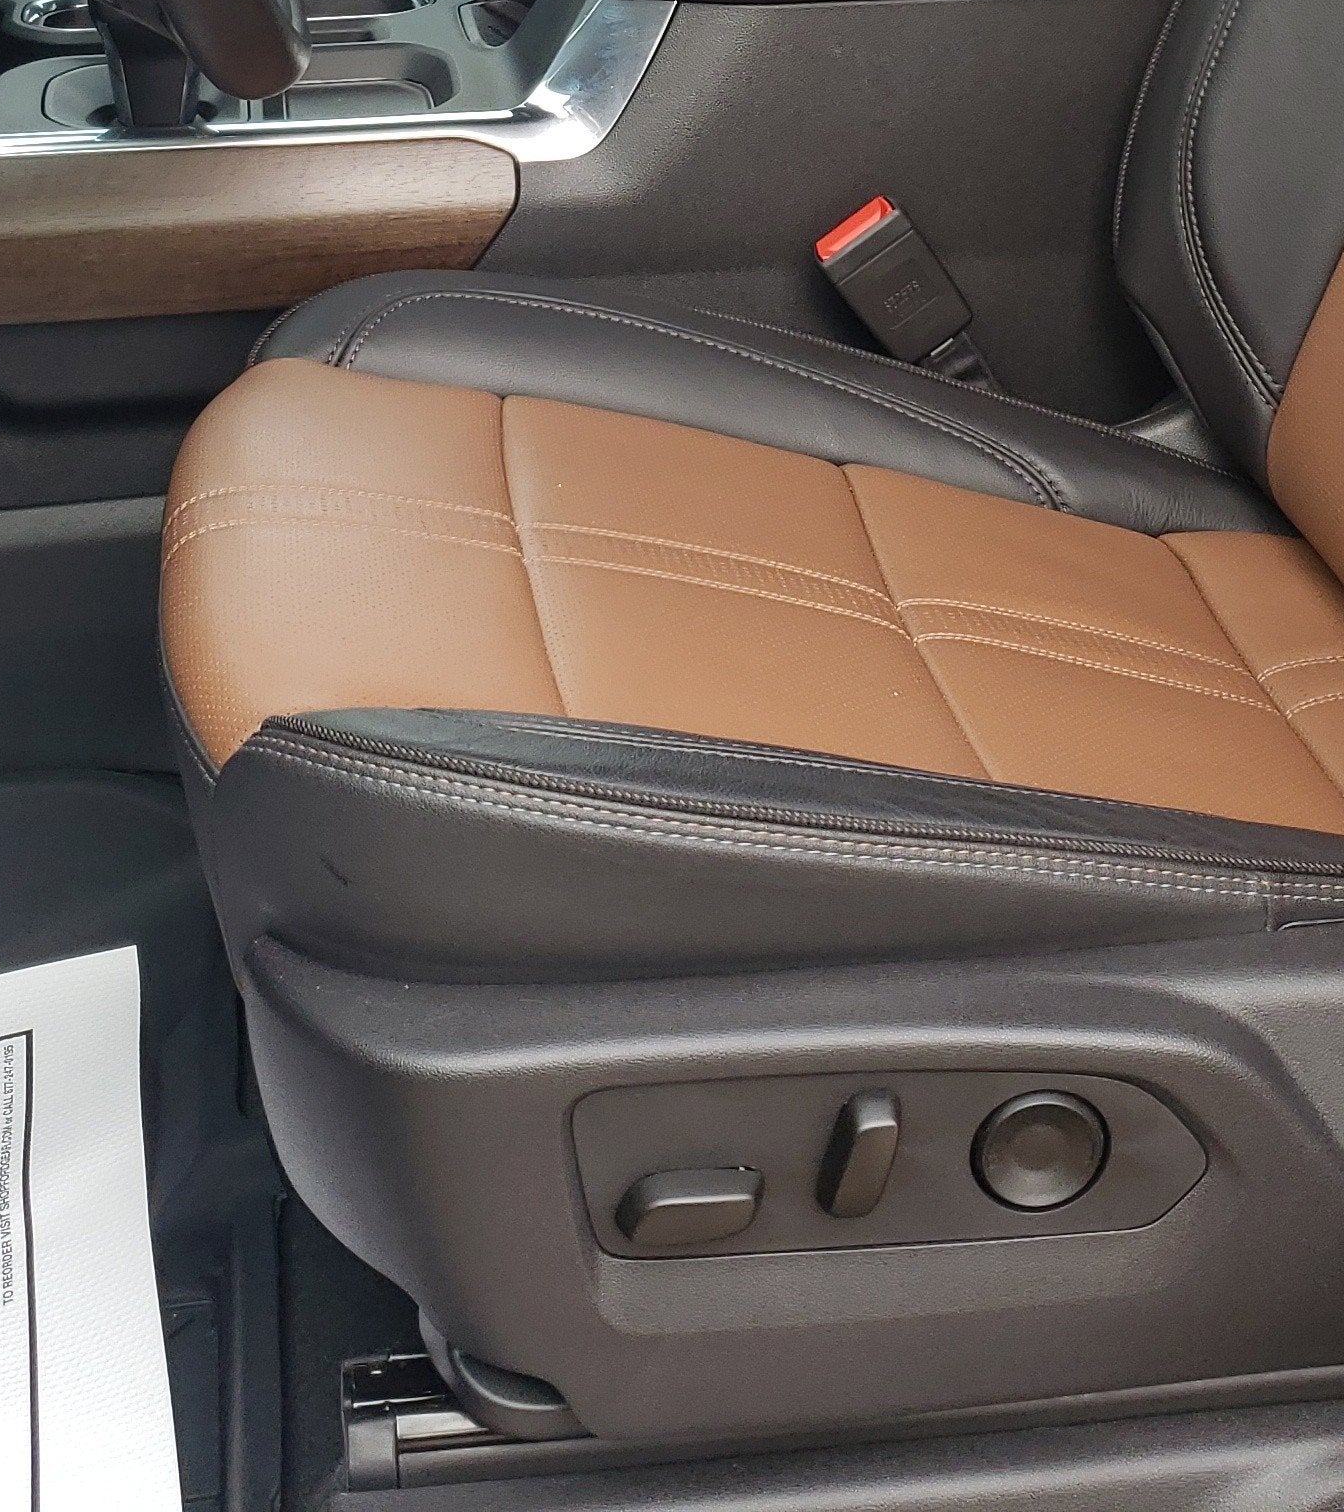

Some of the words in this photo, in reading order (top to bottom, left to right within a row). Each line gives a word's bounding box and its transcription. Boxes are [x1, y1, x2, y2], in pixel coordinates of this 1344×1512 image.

[2, 1094, 14, 1116] CALL
[0, 1213, 12, 1240] VISIT
[1, 1239, 13, 1288] REORDER
[2, 1290, 14, 1306] TO
